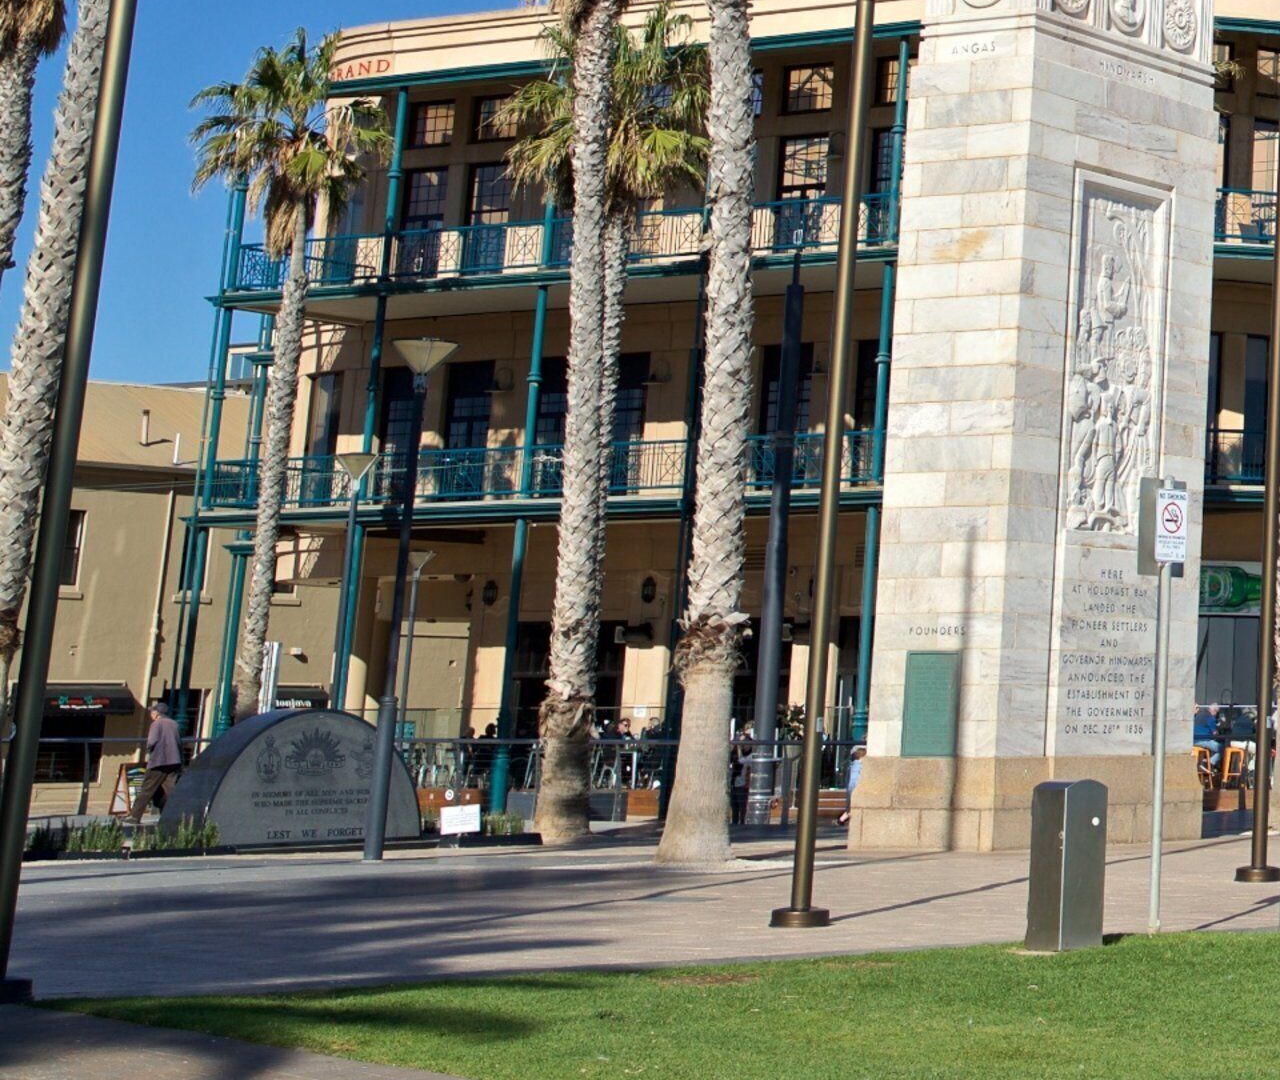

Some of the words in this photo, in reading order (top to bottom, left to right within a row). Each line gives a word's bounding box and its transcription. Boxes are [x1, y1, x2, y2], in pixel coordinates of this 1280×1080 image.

[951, 40, 996, 56] ANGAS
[1100, 569, 1124, 580] HERE
[1072, 584, 1082, 594] AT
[1087, 585, 1129, 597] HOLDFAST
[1083, 602, 1116, 613] LANDED
[1121, 604, 1136, 615] THE
[908, 625, 967, 636] FOUNDERS
[1071, 619, 1108, 631] PIONEER
[1112, 620, 1148, 632] SETTLERS
[1100, 638, 1118, 648] AND
[1062, 654, 1105, 665] GOVERNOR
[1108, 655, 1153, 667] HINDMARSH
[1067, 673, 1125, 683] ANNOUNCED
[1129, 674, 1145, 683] THE
[1067, 689, 1130, 700] ESTABLISHMENT
[1134, 690, 1145, 700] OF
[1066, 706, 1082, 717] THE
[1087, 707, 1145, 717] GOVERNMENT
[1064, 723, 1078, 734] ON
[1125, 724, 1144, 735] 1836
[267, 830, 292, 840] LEST
[301, 829, 317, 839] WE
[327, 827, 364, 838] FORGET
